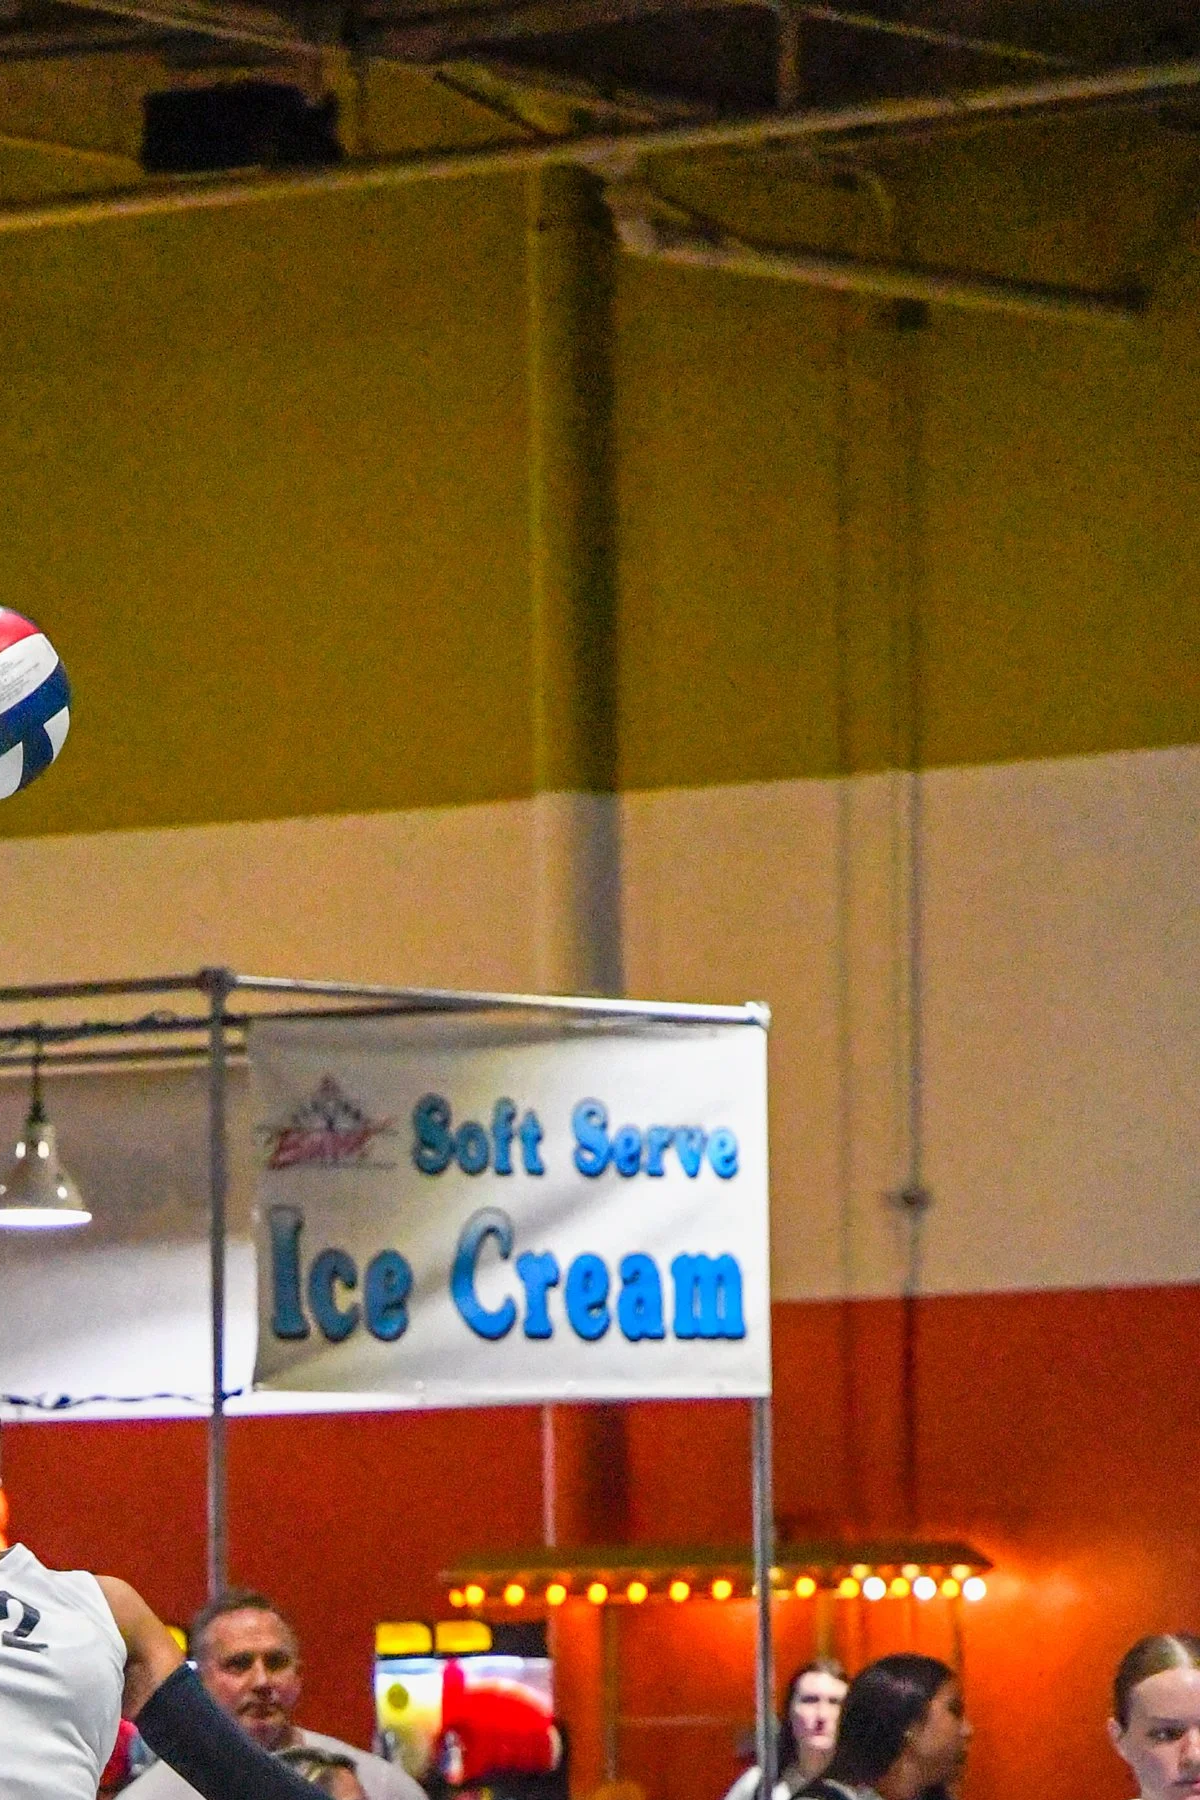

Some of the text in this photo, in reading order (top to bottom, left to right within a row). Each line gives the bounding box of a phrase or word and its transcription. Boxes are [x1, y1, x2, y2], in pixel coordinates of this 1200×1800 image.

[411, 1092, 545, 1176] Soft
[571, 1097, 739, 1179] Serve
[268, 1204, 746, 1342] Ice Cream
